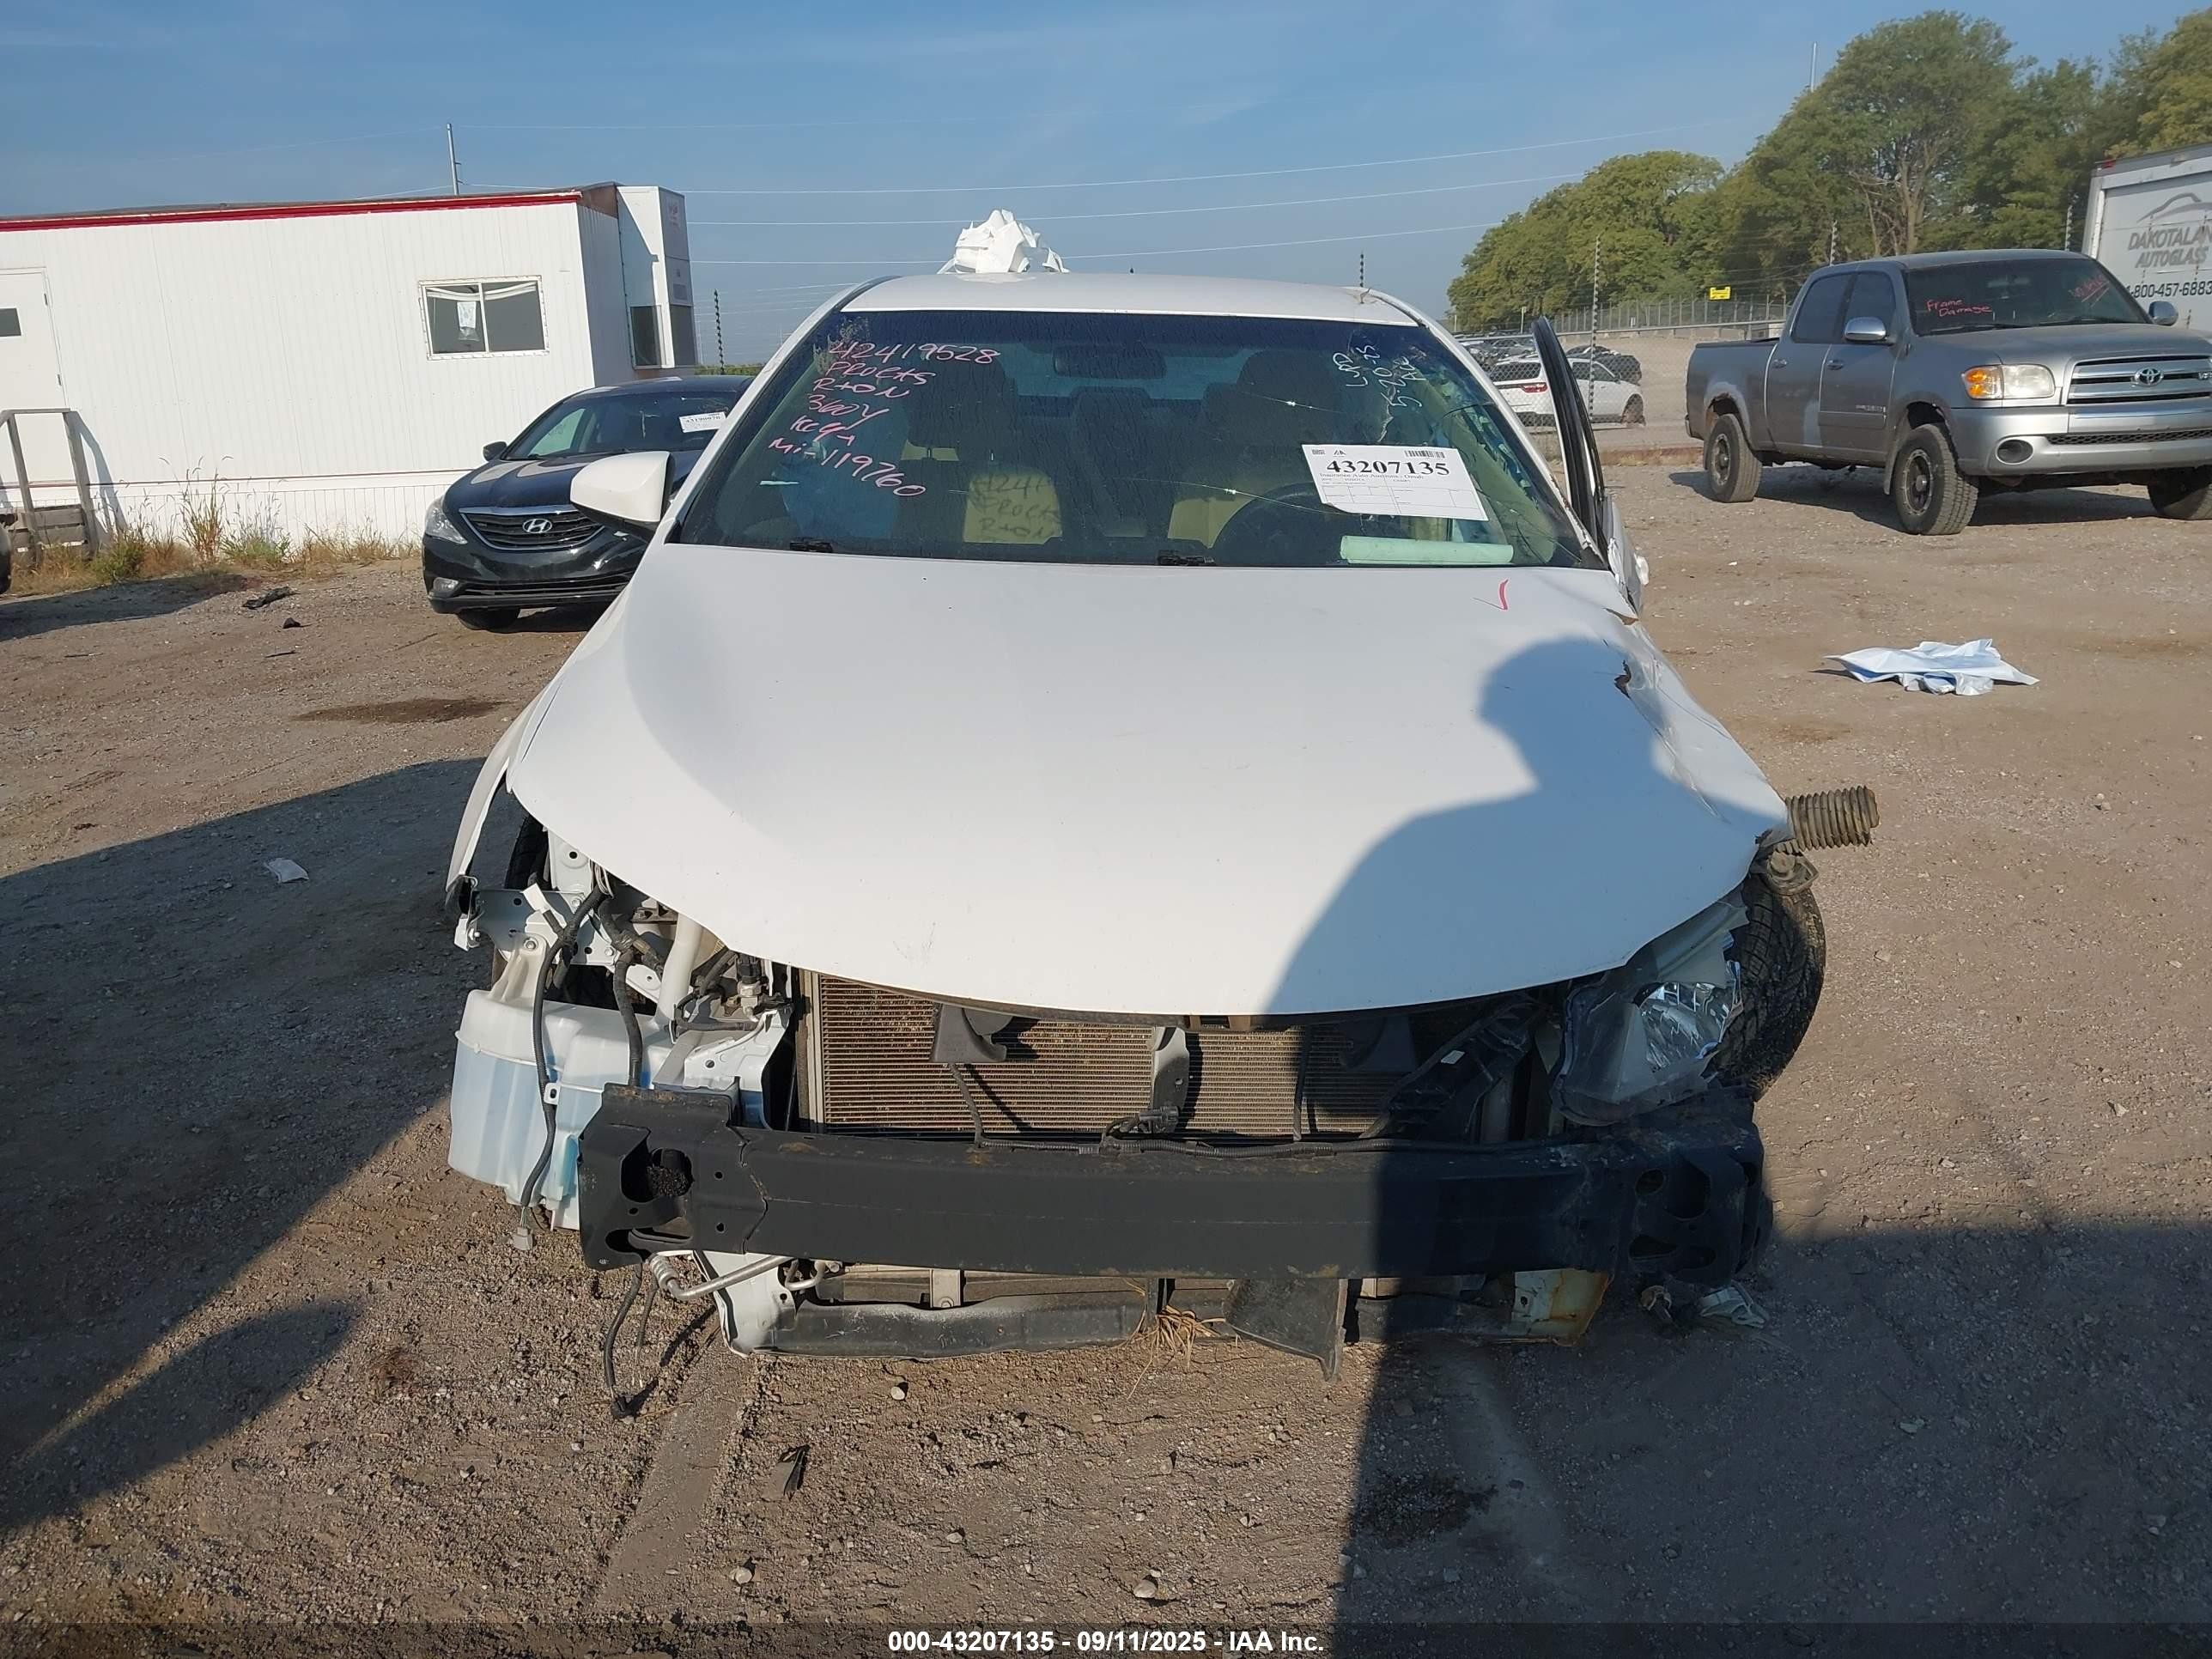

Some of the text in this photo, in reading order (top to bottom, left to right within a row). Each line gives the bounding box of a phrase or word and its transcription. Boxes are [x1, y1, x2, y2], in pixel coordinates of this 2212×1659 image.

[2135, 246, 2209, 268] AUTOGLASS
[1927, 300, 1963, 312] Frame
[829, 341, 1001, 364] 42419528
[1326, 459, 1450, 476] 43207135
